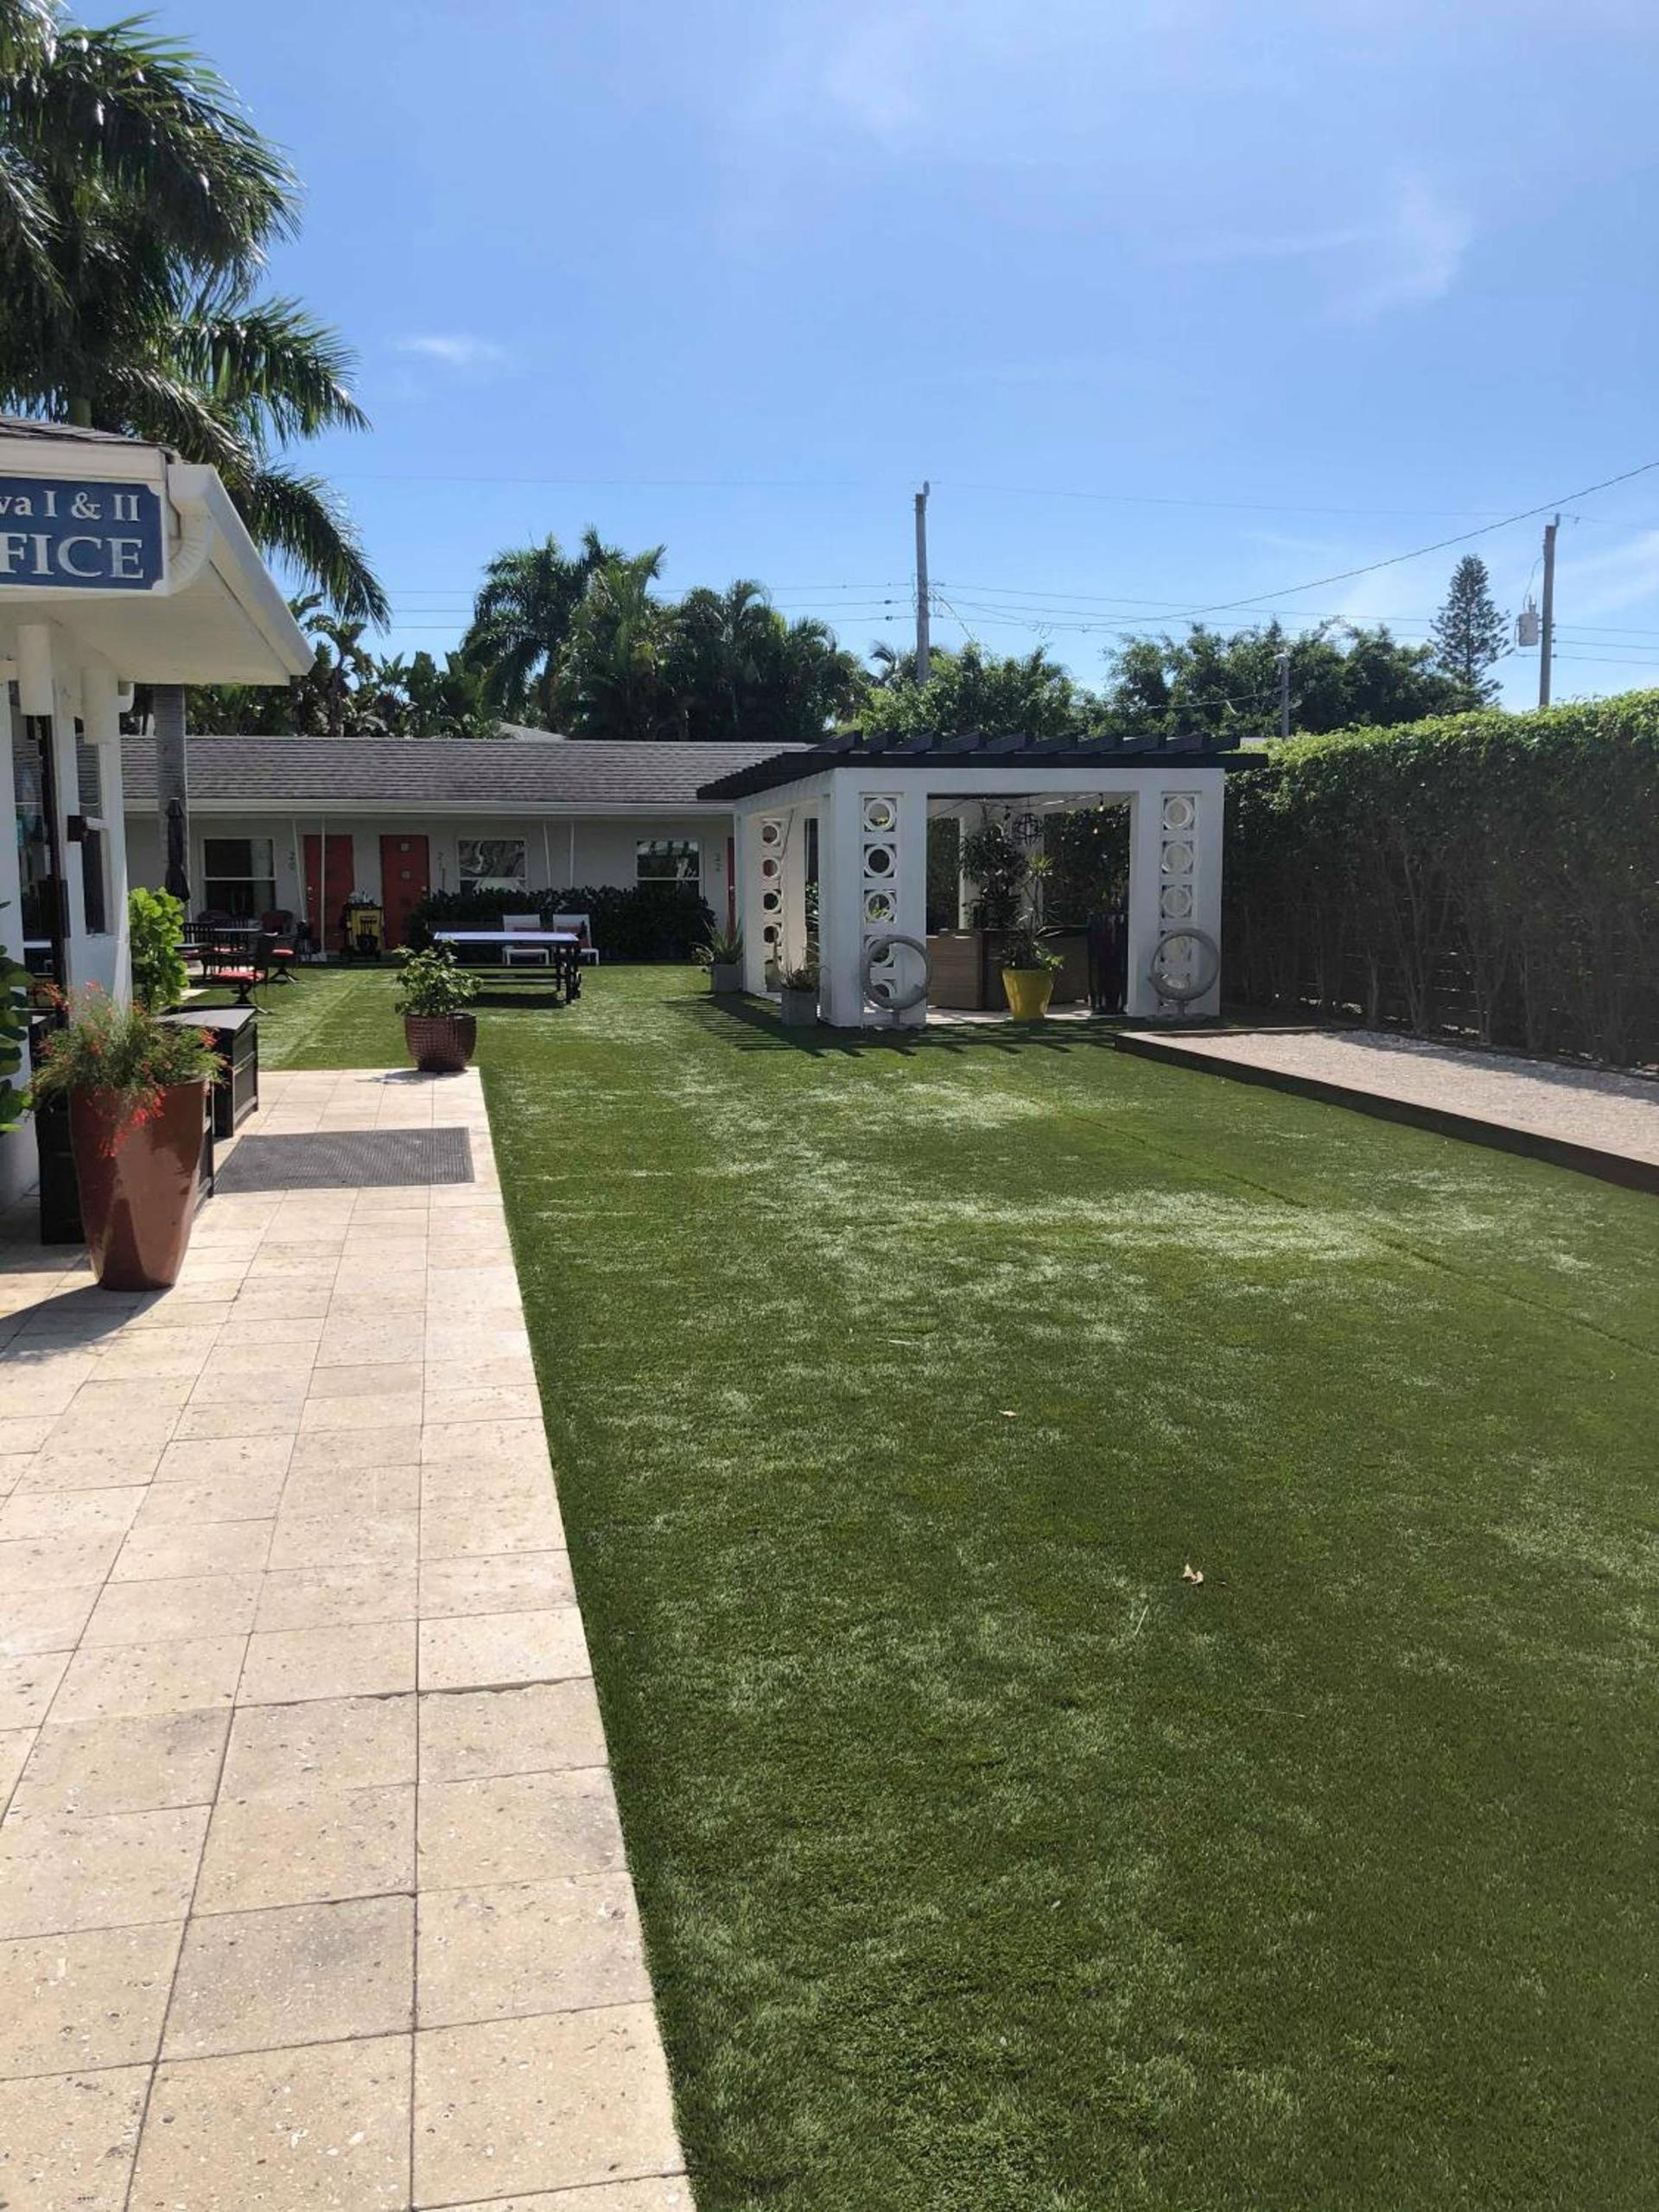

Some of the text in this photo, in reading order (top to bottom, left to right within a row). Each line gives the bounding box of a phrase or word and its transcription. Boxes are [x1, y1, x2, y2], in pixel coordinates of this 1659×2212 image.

[44, 490, 59, 518] I
[71, 492, 103, 520] &
[112, 493, 141, 522] II
[0, 531, 144, 579] FICE
